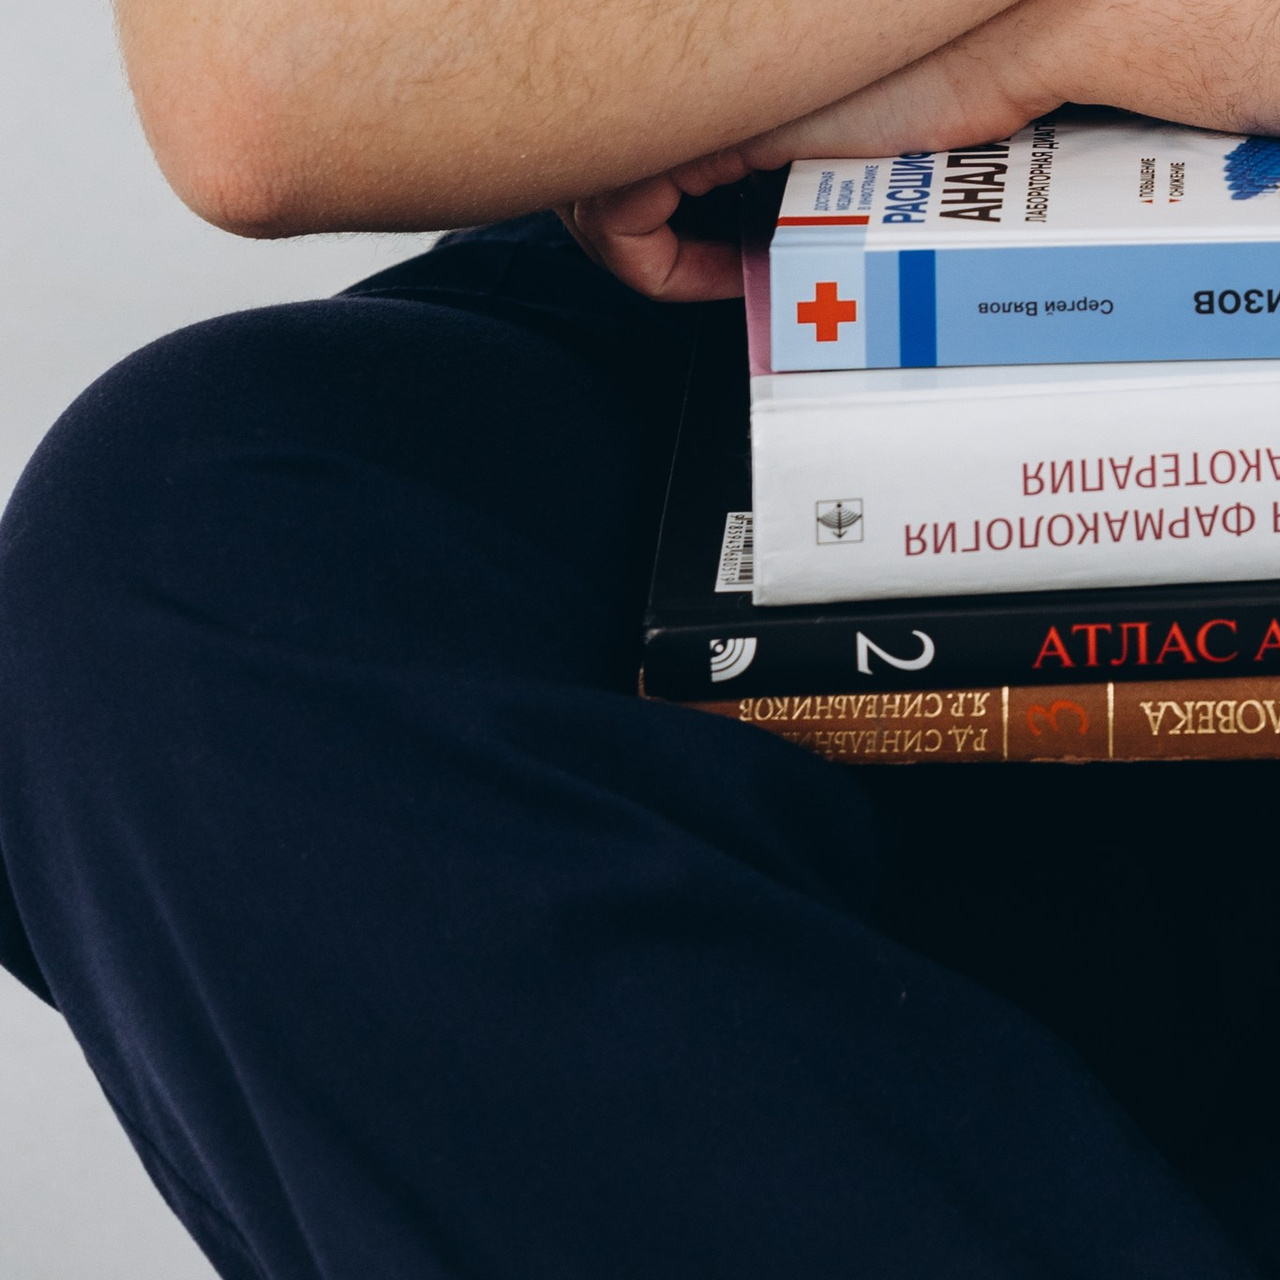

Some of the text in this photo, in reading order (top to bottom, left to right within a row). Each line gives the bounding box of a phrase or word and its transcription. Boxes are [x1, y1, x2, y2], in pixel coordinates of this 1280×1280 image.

[813, 171, 836, 212] ДОСТОВЕРНАЯ
[835, 179, 857, 211] МЕДИЦИНА
[857, 165, 880, 206] ИНФОГРАФИКЕ
[1025, 151, 1054, 223] ЛАБОРАТОРНАЯ
[1138, 157, 1156, 198] ПОВЫШЕНИЕ
[1169, 162, 1185, 198] СНИЖЕНИЕ
[977, 297, 1114, 316] Сергей Вялов
[904, 501, 1257, 557] ФАРМАКОЛОГИЯ
[856, 629, 936, 676] 2
[1031, 617, 1240, 670] АТЛАС
[738, 692, 944, 722] СИНЕЛЬНИКОВ
[1025, 698, 1089, 738] 3
